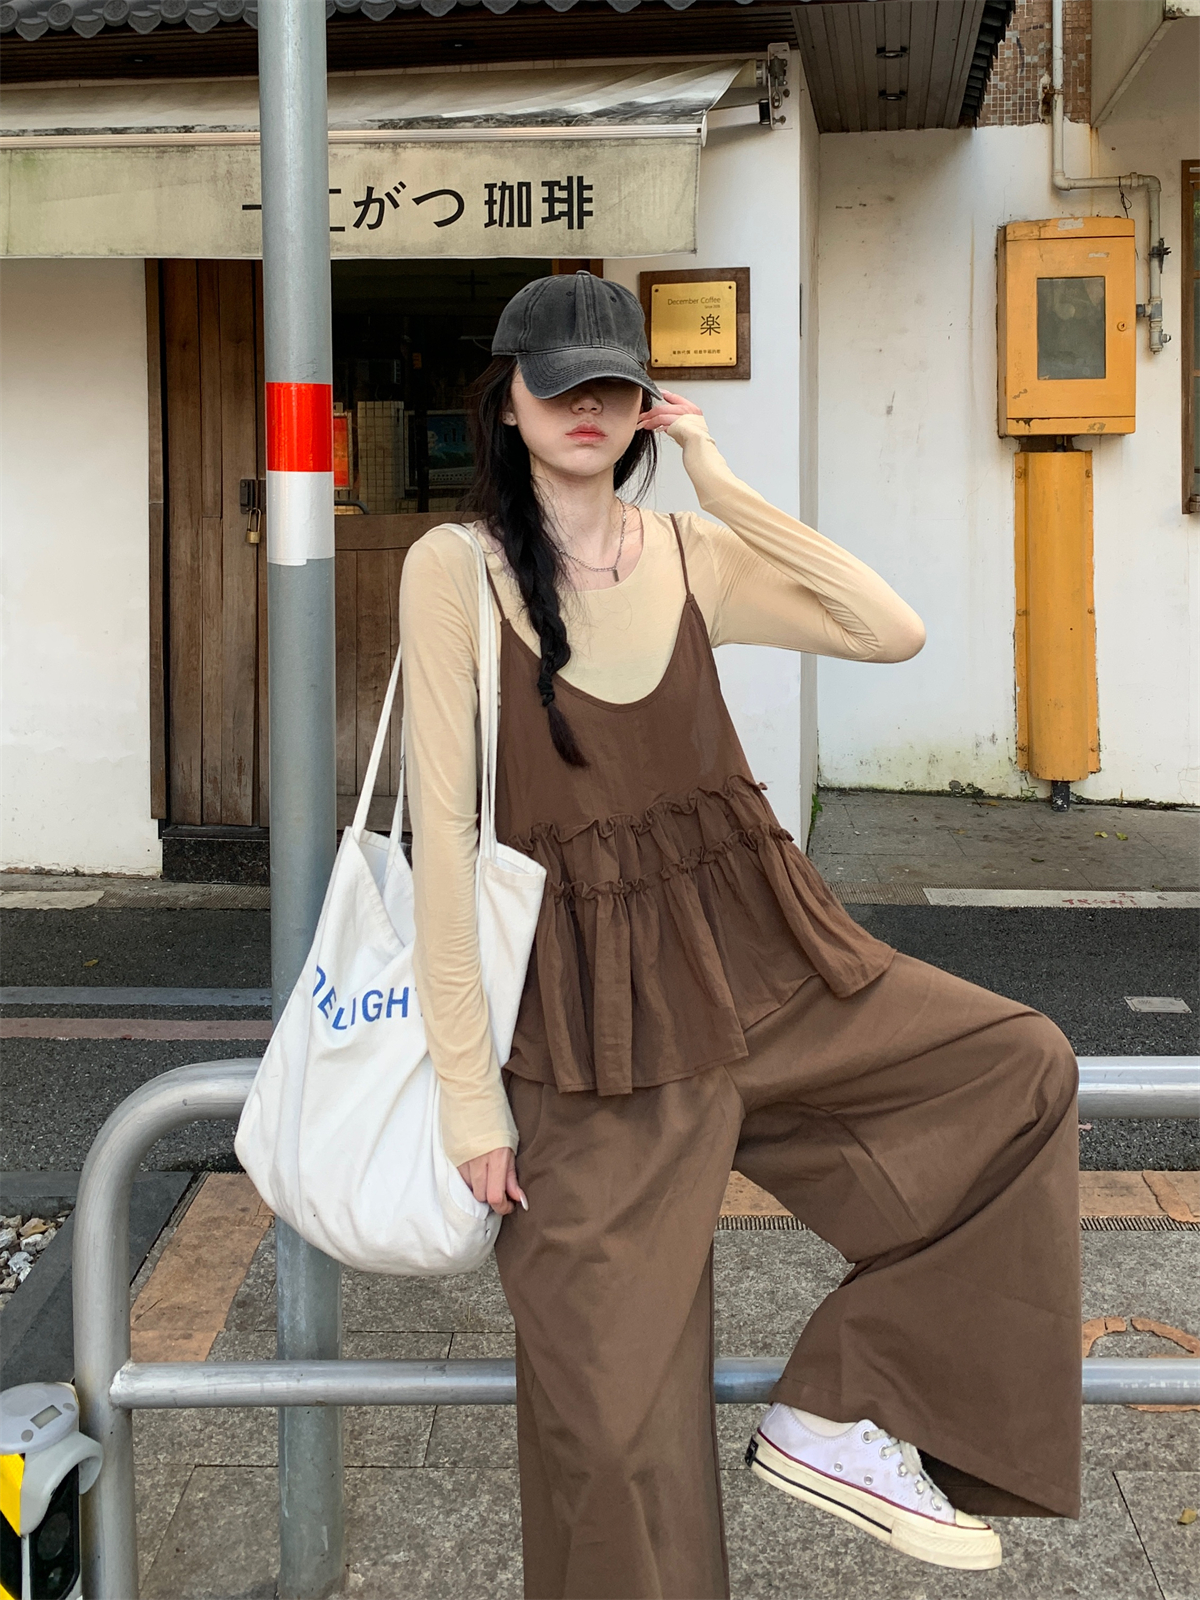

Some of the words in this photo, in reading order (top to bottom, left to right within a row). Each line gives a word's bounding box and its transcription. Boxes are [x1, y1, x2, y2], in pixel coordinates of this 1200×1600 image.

[484, 176, 593, 229] 珈琲
[700, 313, 721, 336] 楽
[313, 965, 422, 1030] DELIGH
